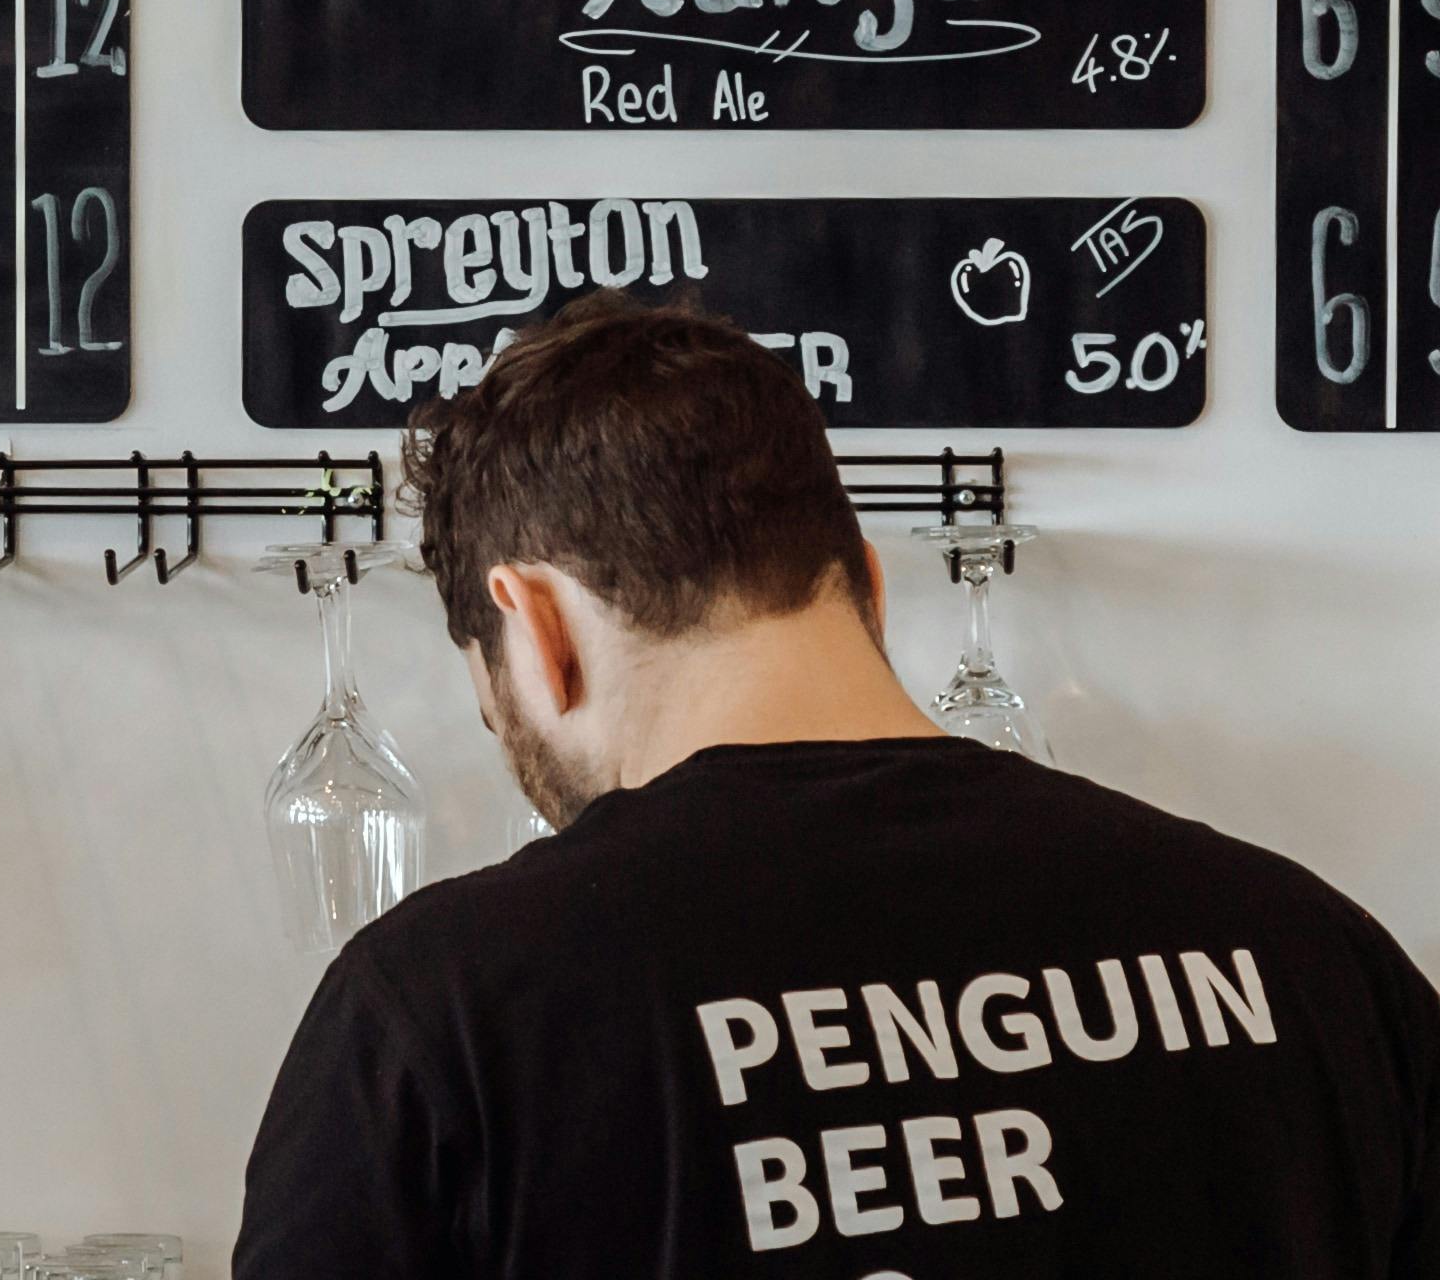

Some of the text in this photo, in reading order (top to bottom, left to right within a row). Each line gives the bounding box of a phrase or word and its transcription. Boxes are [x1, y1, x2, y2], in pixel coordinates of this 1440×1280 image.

[583, 65, 770, 123] Red Ale
[696, 949, 1277, 1106] PENGUIN
[734, 1109, 1063, 1252] BEER
